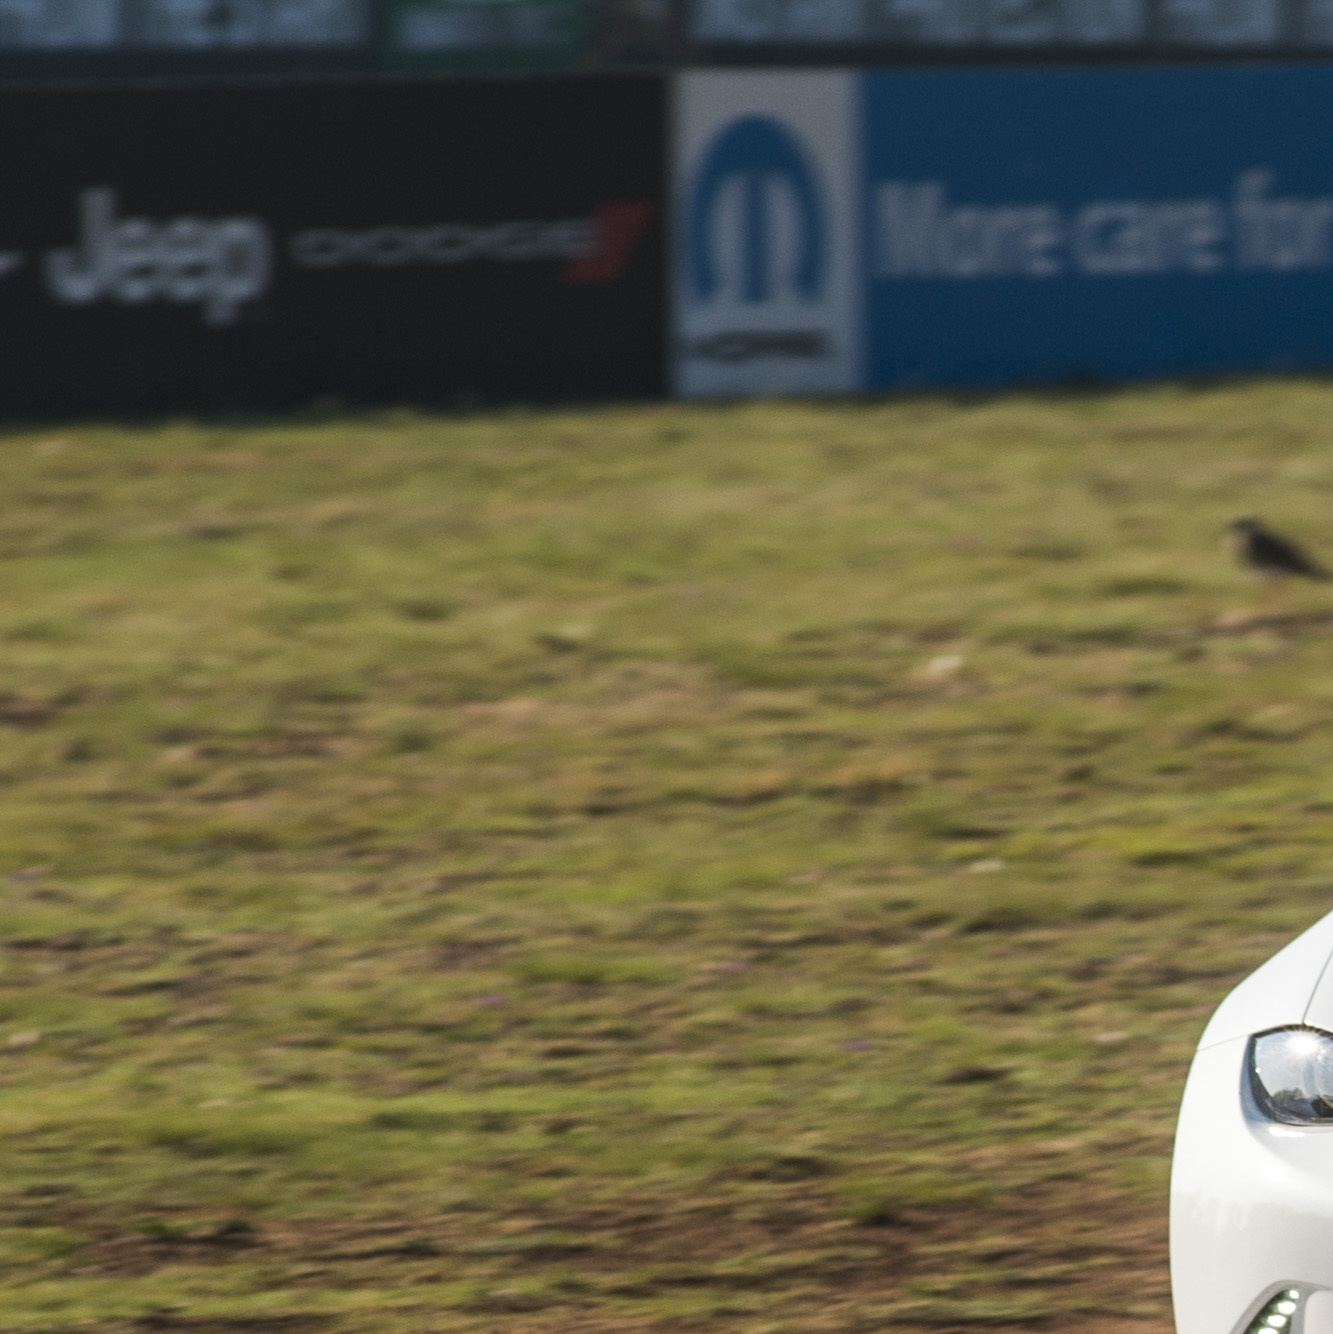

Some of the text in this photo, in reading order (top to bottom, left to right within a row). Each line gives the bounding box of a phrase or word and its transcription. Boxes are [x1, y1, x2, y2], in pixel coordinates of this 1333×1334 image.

[44, 188, 272, 325] Jeep
[875, 181, 1060, 278] More
[1073, 200, 1226, 274] care
